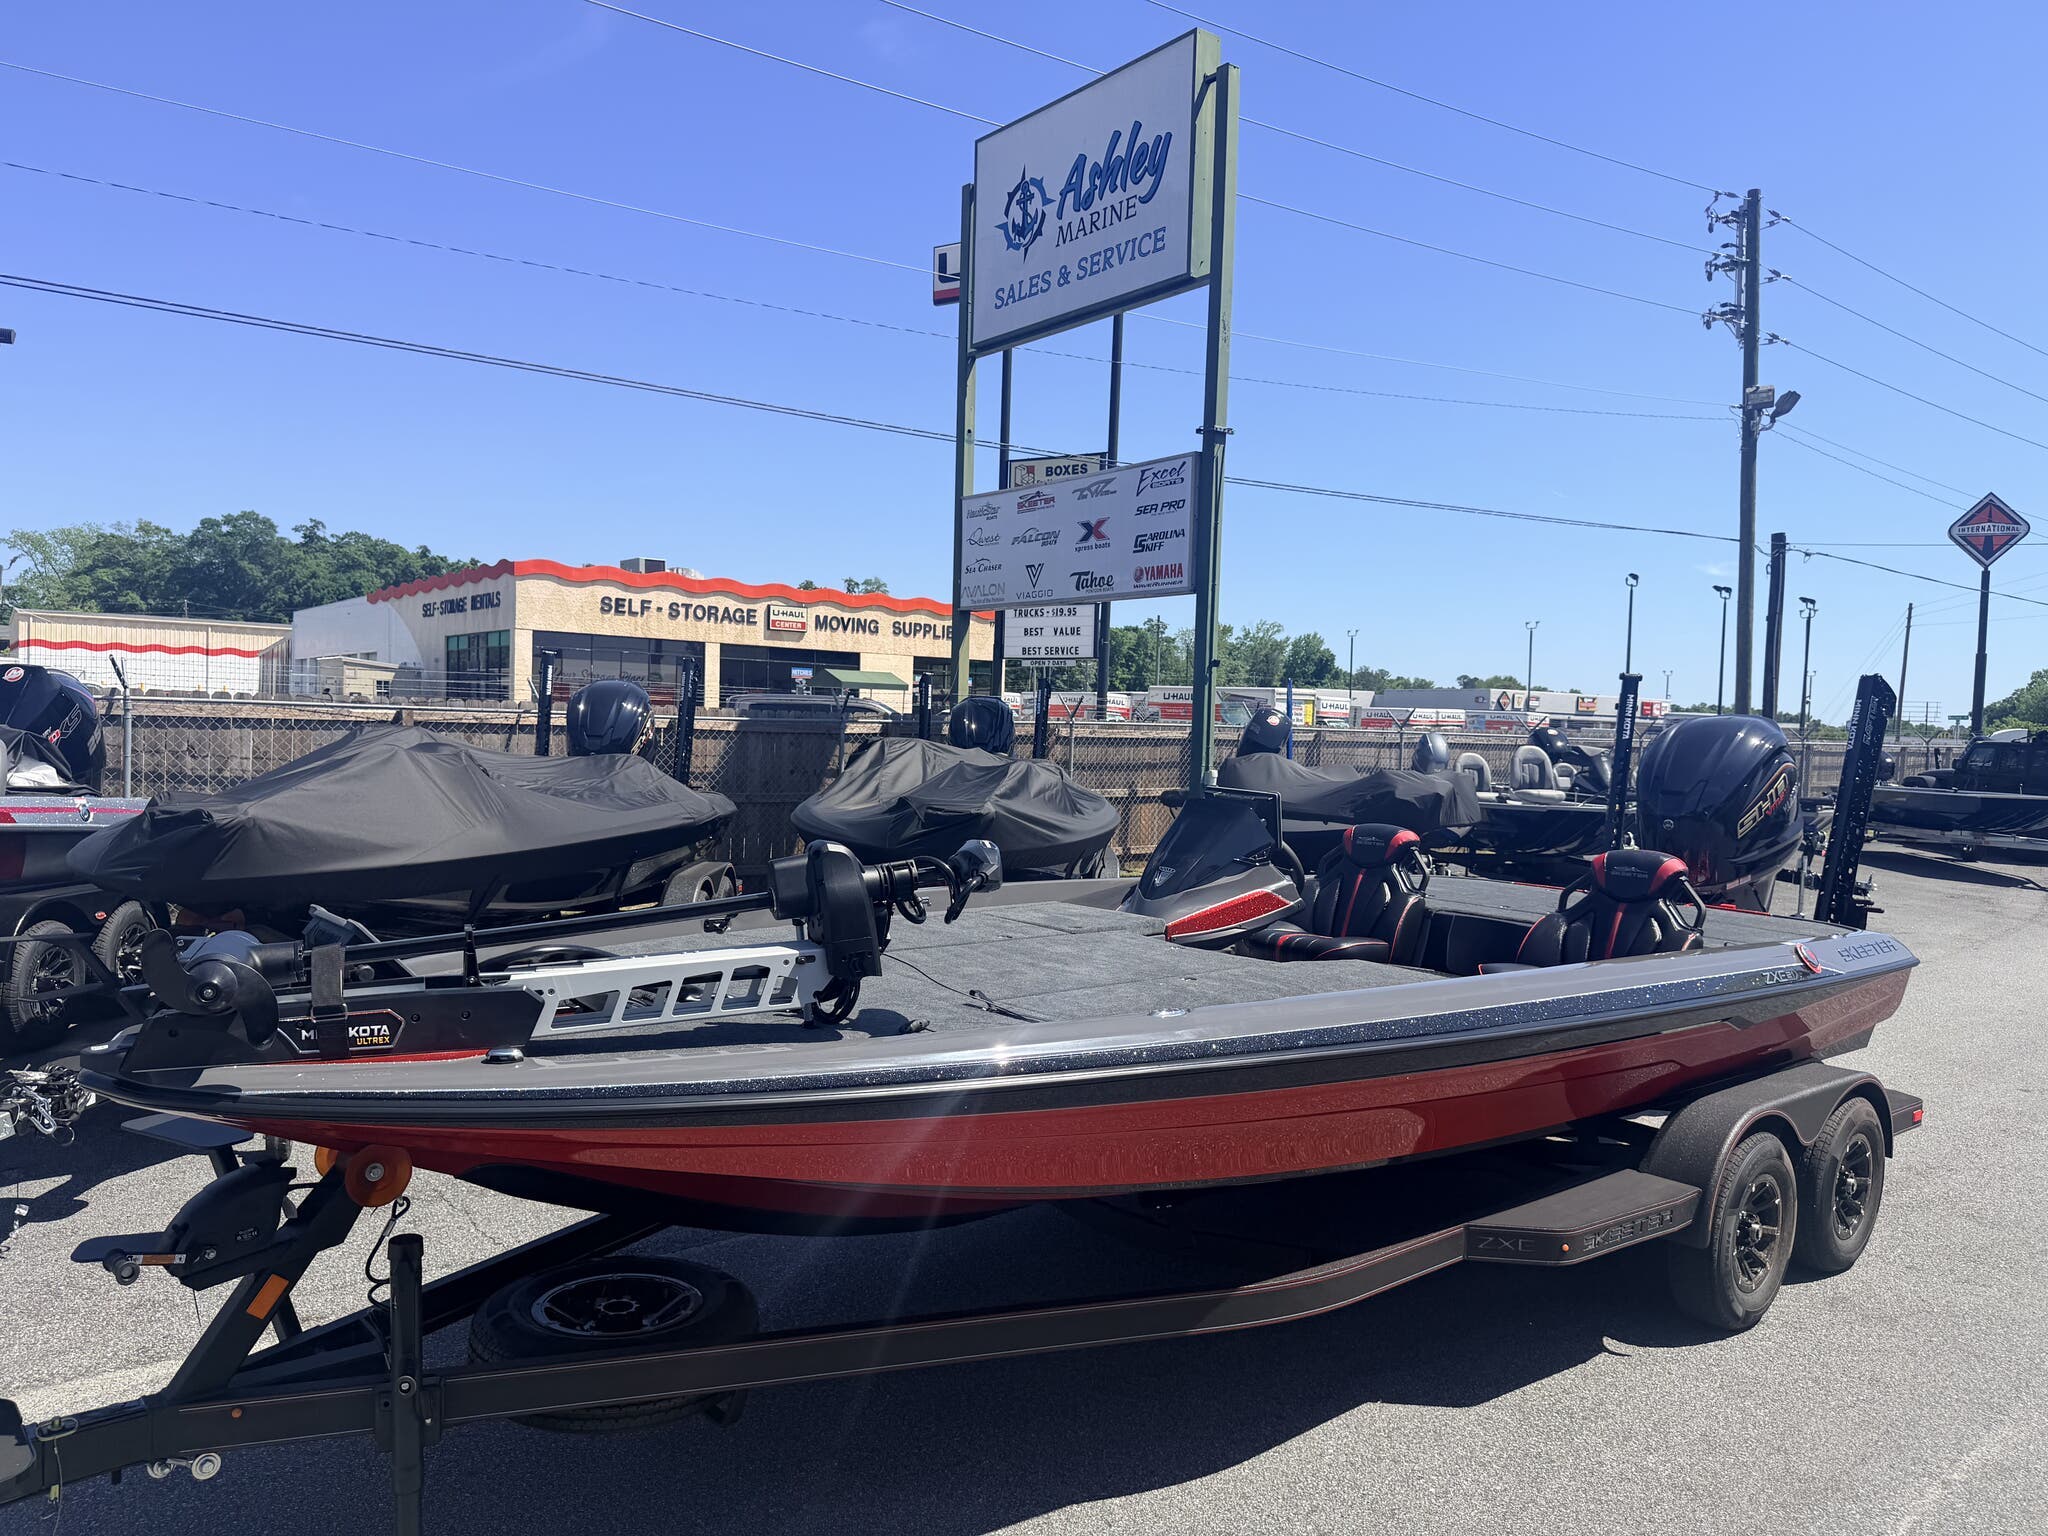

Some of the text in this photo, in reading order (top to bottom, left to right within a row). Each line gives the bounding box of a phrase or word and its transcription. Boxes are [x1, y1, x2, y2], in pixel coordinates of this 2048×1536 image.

[1056, 120, 1173, 220] Ashley
[1055, 194, 1138, 248] MARINE
[994, 227, 1167, 310] SALES & SERVICE
[1045, 463, 1088, 477] BOXES
[1135, 460, 1187, 497] Excel
[1134, 499, 1186, 516] SEA PRO
[1011, 528, 1061, 546] FALCON
[1134, 528, 1186, 547] CAROLINA
[1957, 524, 2020, 533] INTERNATIONAL
[1133, 539, 1165, 553] SKIFF
[1070, 570, 1115, 592] Tahoe
[1144, 563, 1183, 581] YAMAHA
[960, 582, 1006, 599] AVALON
[1016, 589, 1054, 600] VIAGGIO
[471, 591, 501, 611] RENTALS
[668, 602, 758, 625] STORAGE
[1013, 608, 1045, 618] TRUCKS
[1051, 607, 1077, 617] $19.95
[775, 621, 802, 630] CENTER
[814, 614, 953, 641] MOVING SUPPLIE
[1024, 626, 1081, 636] BEST VALUE
[1022, 646, 1079, 656] BEST SERVICE
[1622, 694, 1635, 740] MINN KOTA
[1846, 698, 1863, 750] MINN KOTA
[1837, 938, 1898, 963] SKEETER
[348, 1024, 390, 1038] KOTA
[356, 1036, 390, 1046] ULTREX
[1582, 1208, 1673, 1252] SKEETER
[1477, 1235, 1536, 1253] ZXE
